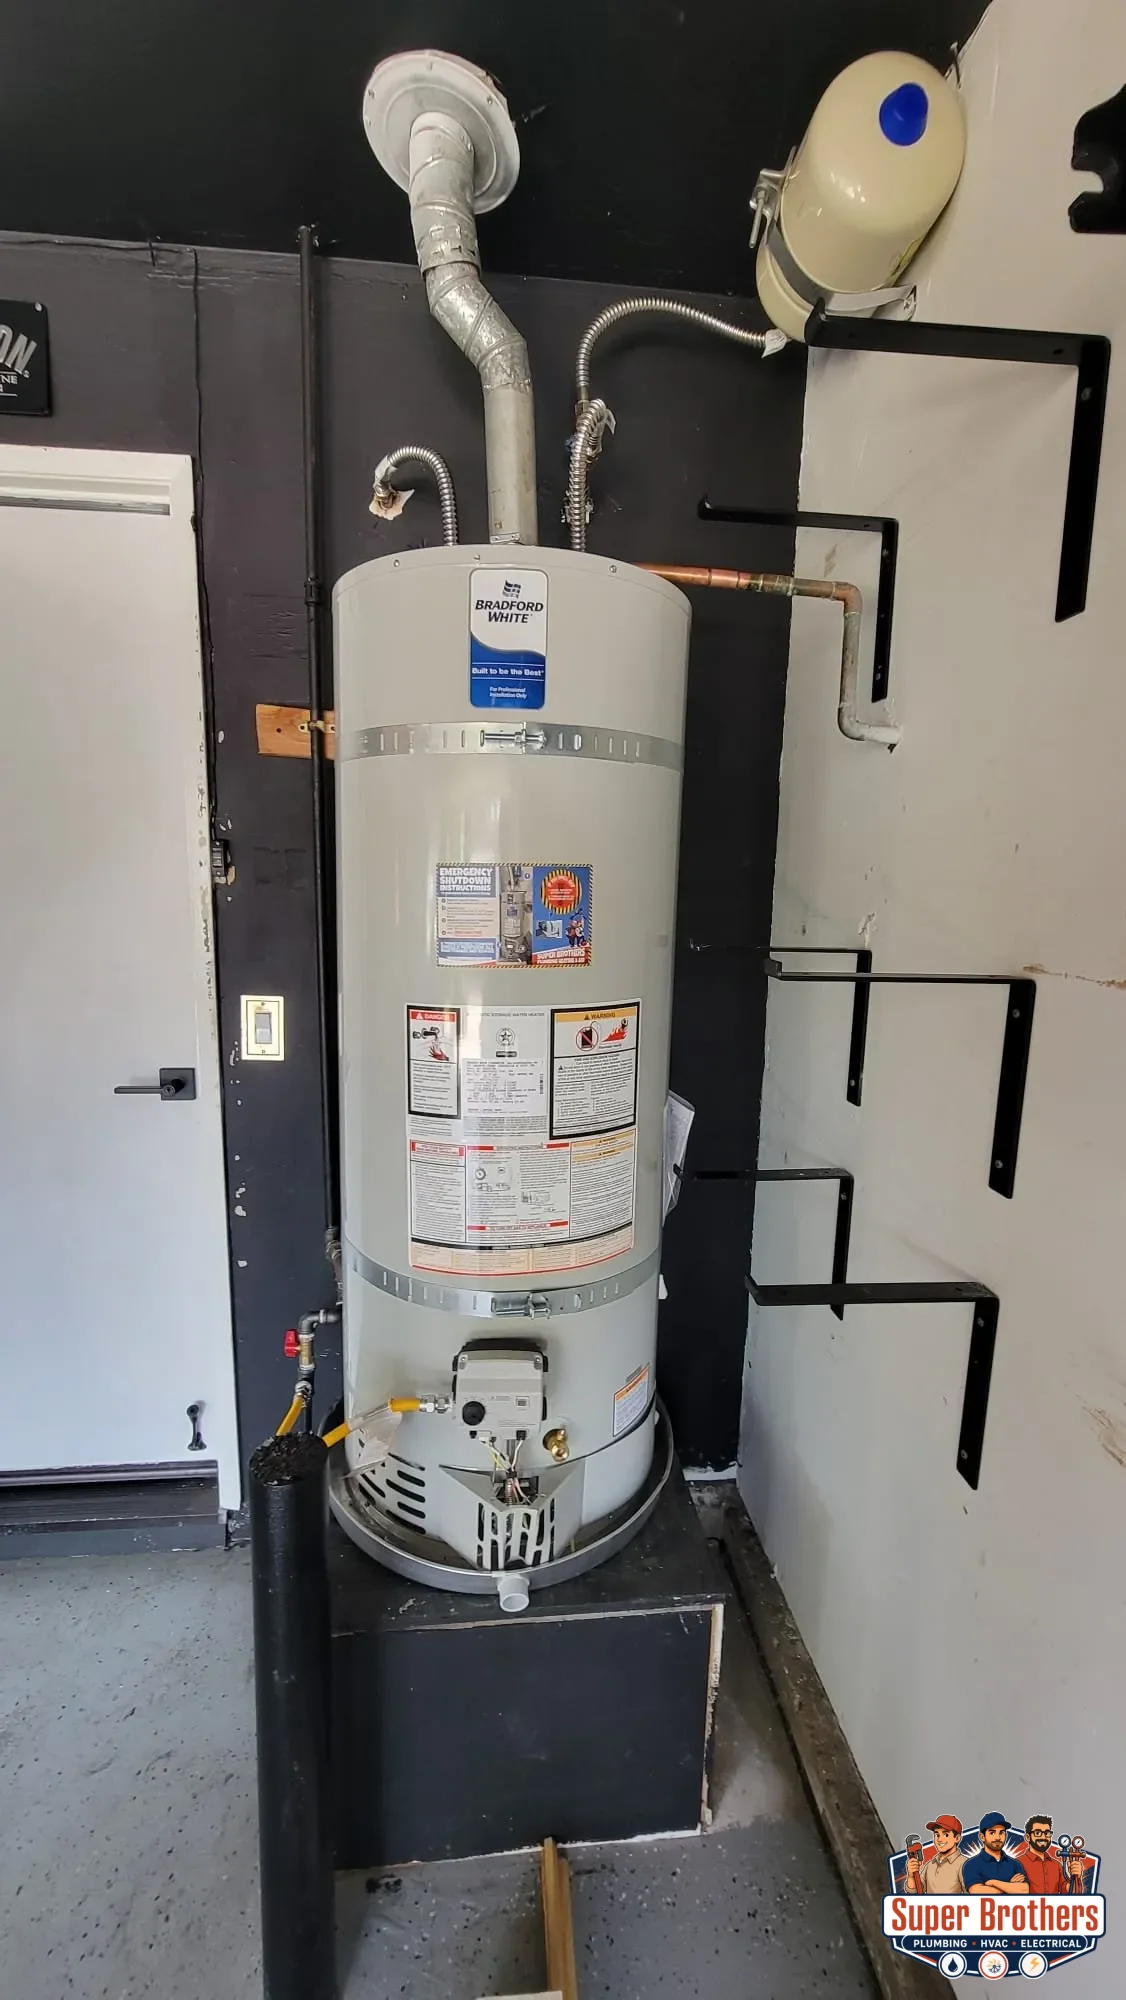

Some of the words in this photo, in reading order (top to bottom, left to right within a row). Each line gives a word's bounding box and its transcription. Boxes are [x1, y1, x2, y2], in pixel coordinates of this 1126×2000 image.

[475, 599, 544, 612] BRADFORD
[488, 611, 529, 623] WHITE
[472, 667, 488, 675] Built
[499, 667, 509, 675] be
[510, 668, 523, 676] the
[439, 867, 493, 876] EMERGENCY
[439, 876, 492, 884] SHUTDOWN
[590, 1012, 615, 1020] WARNING
